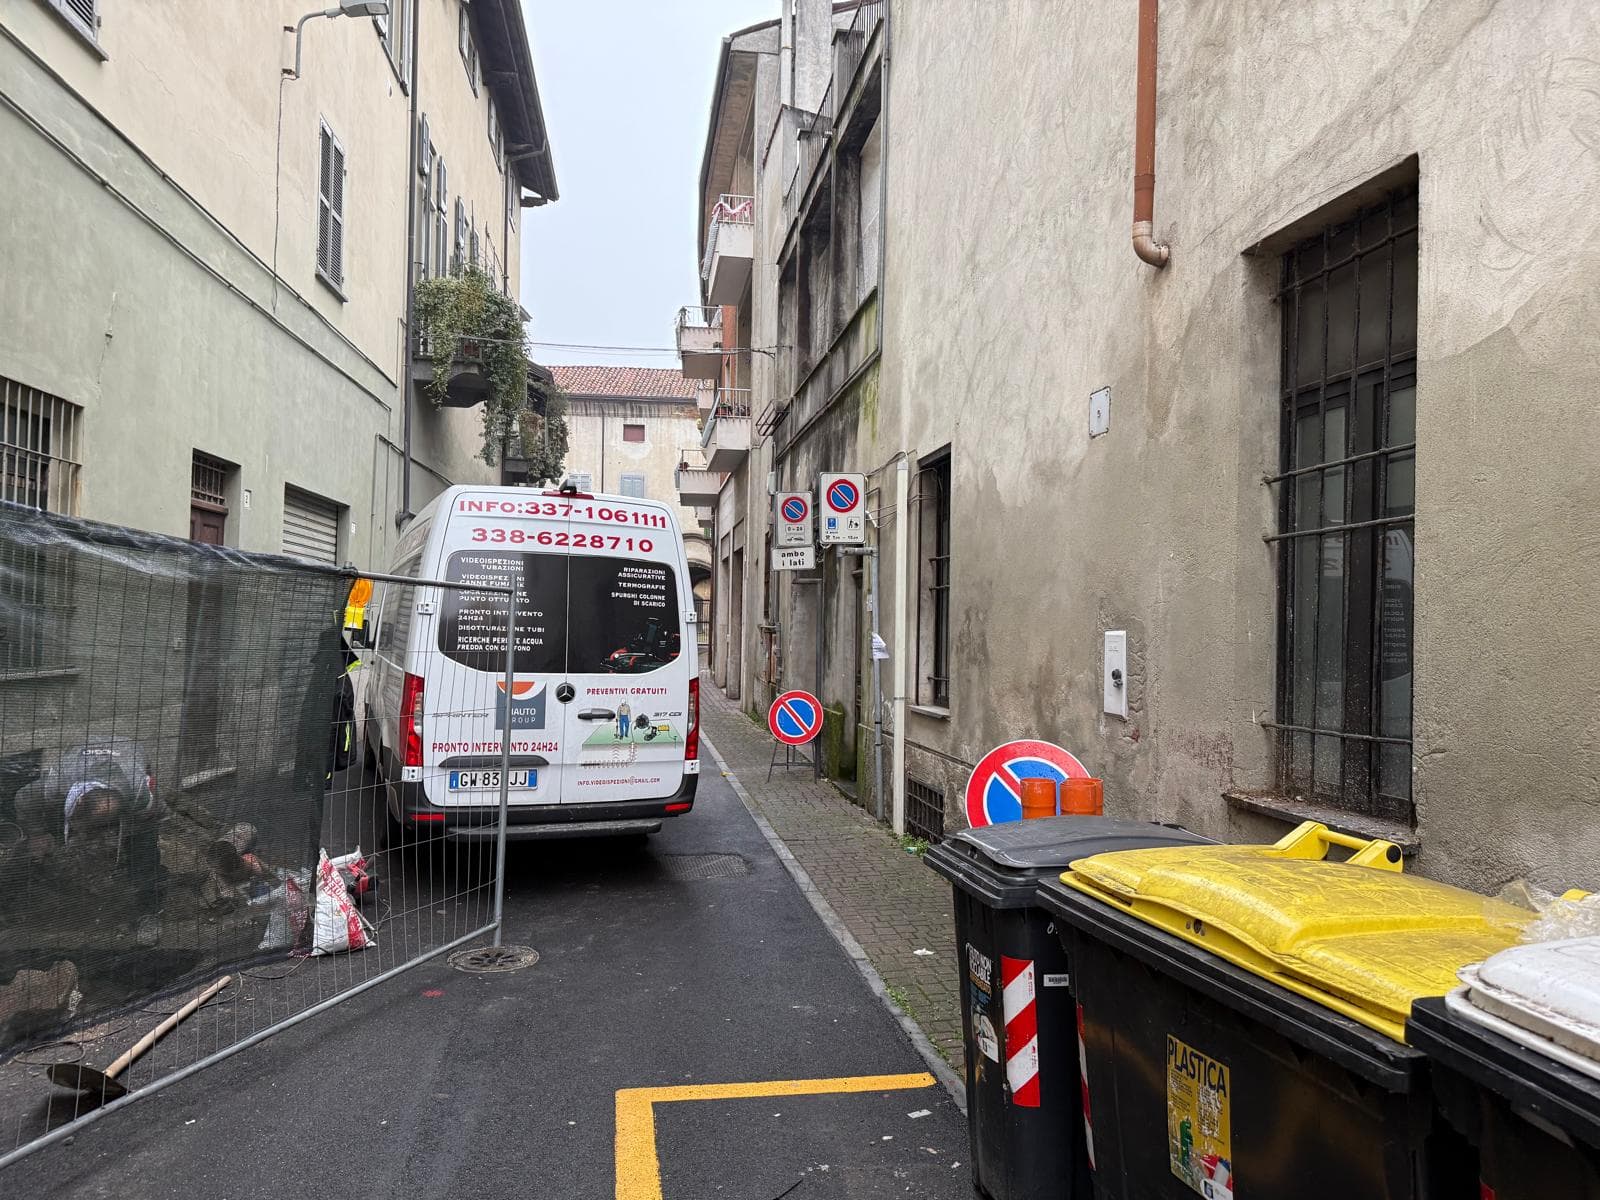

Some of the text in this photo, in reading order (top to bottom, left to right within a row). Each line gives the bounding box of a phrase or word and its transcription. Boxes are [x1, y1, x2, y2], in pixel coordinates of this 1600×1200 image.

[459, 500, 667, 528] INFO:337-1061111
[471, 528, 654, 553] 338-6228710
[460, 557, 524, 565] VIDEOISPEZIONI
[623, 567, 666, 575] RIPARAZIONI
[461, 573, 525, 582] VIDEOISPEZNI
[617, 572, 666, 581] ASSICURATIVE
[617, 582, 666, 590] TERMOGRAFIE
[457, 636, 490, 644] RICERCHE
[630, 687, 667, 695] GRATUITI
[432, 742, 469, 753] PRONTO
[530, 742, 558, 752] 24H24
[460, 772, 478, 787] GW
[1167, 1037, 1228, 1098] PLASTICA
